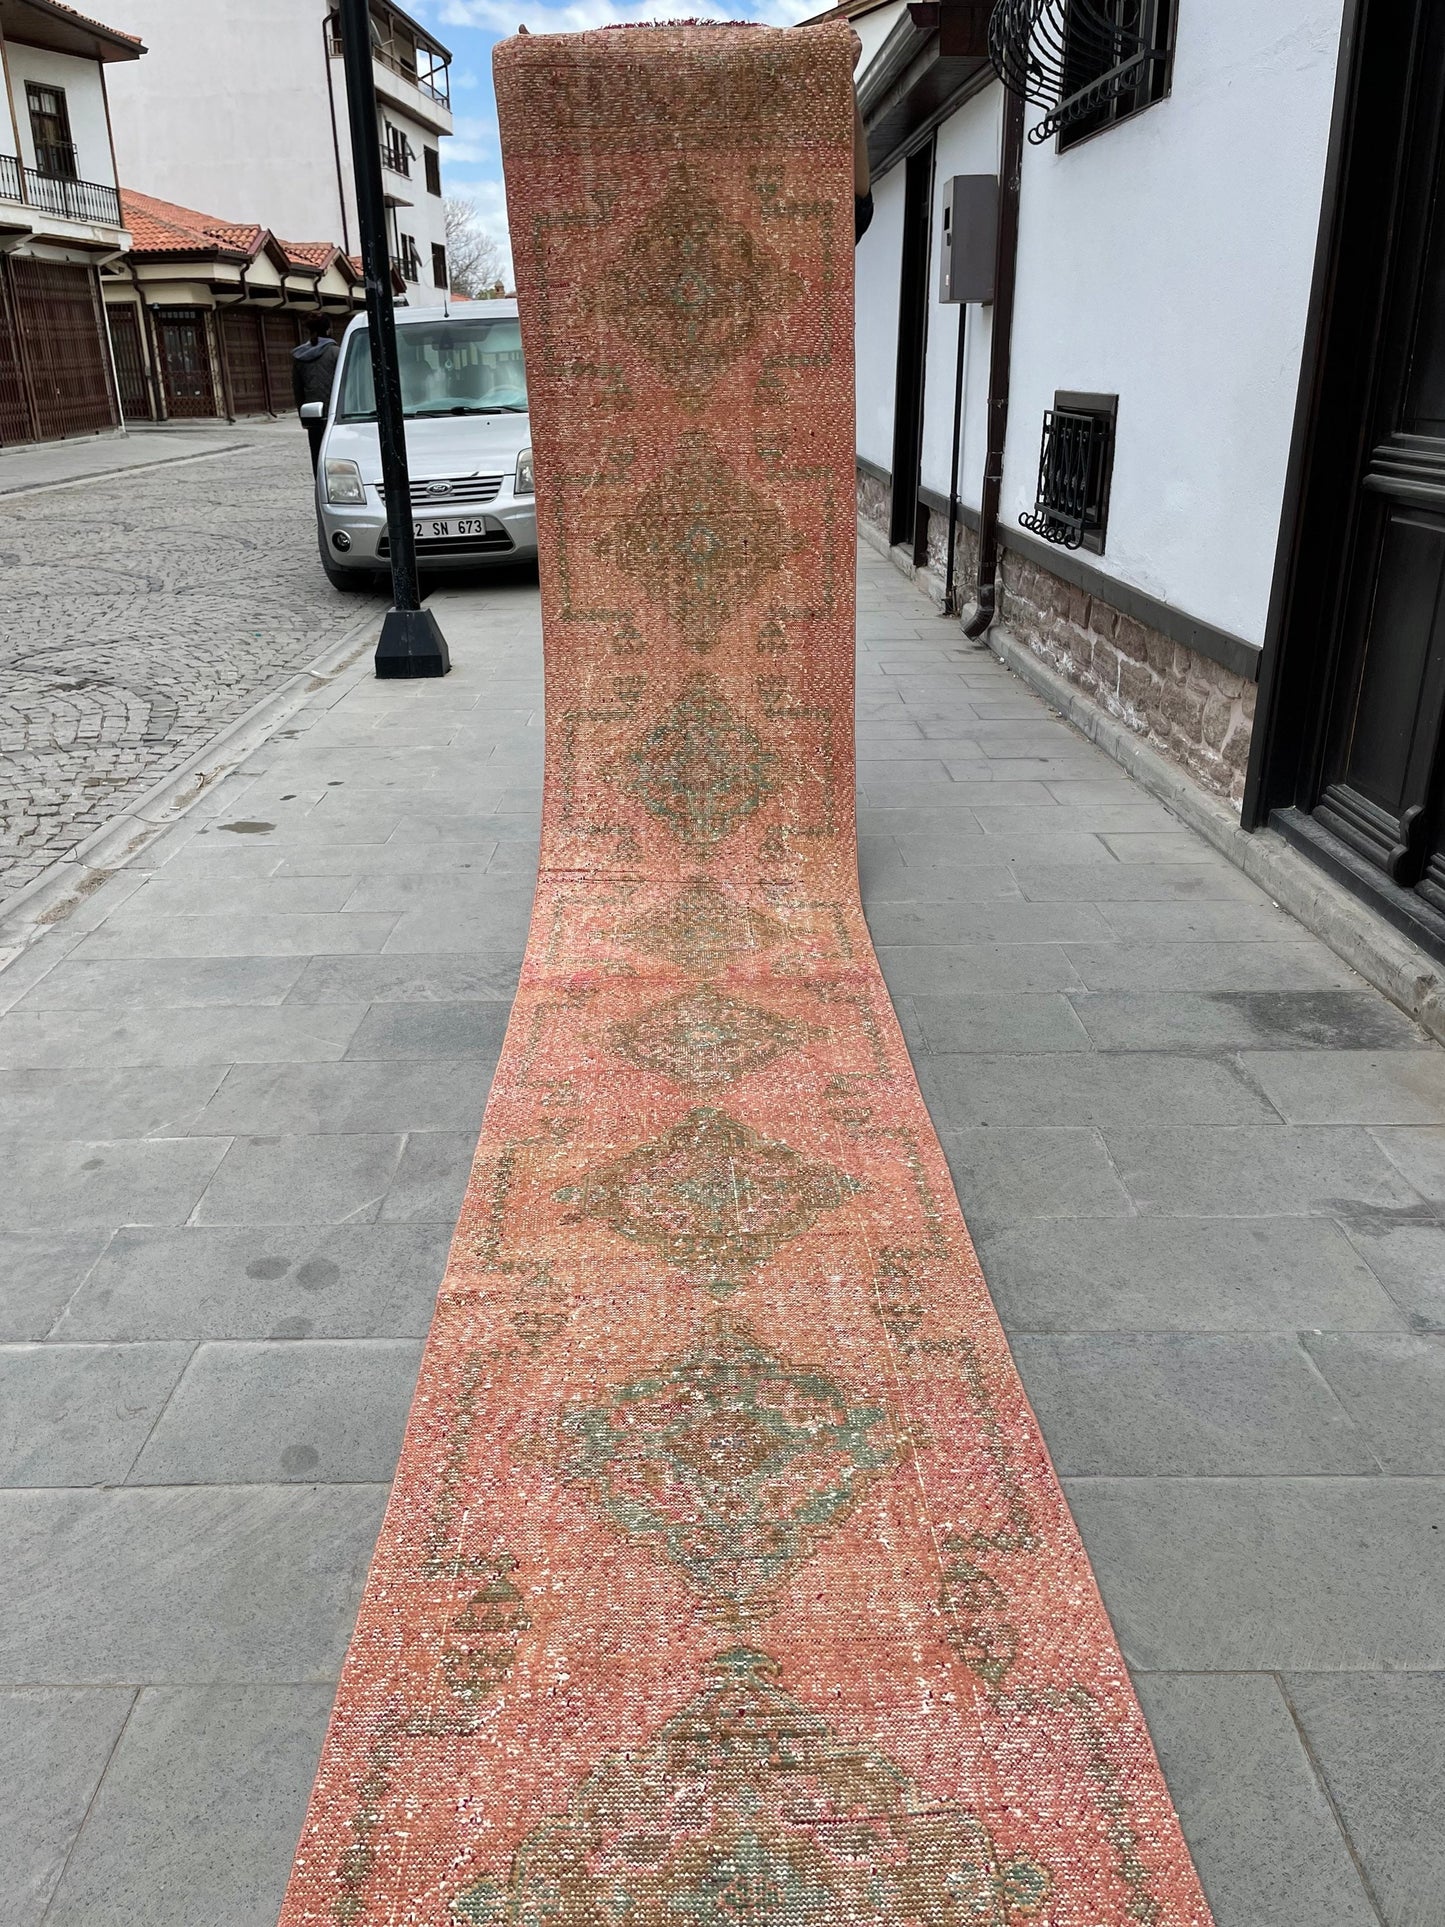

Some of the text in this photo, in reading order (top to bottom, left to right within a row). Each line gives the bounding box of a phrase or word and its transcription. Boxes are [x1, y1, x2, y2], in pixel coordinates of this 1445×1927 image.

[414, 520, 482, 537] 2 SN 673
